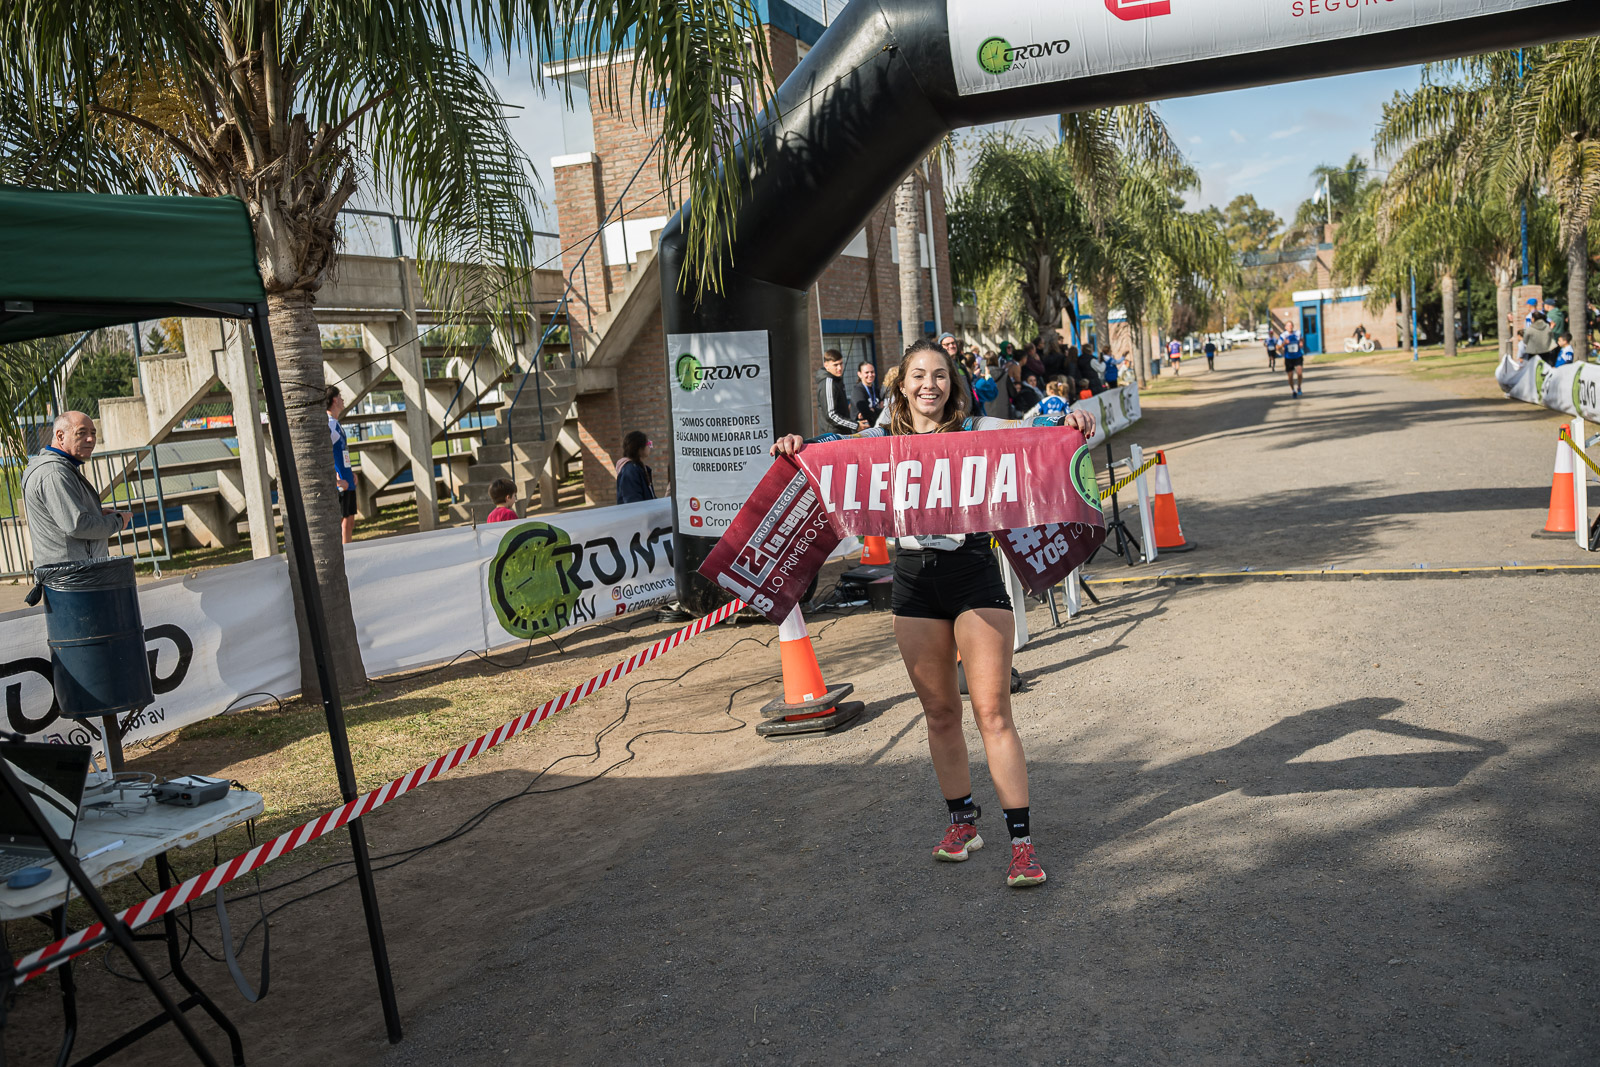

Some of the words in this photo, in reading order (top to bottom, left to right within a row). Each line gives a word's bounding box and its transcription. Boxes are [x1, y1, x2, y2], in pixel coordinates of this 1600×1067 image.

[1291, 0, 1395, 17] SEGU
[1003, 62, 1027, 72] RAV
[692, 382, 715, 391] RAV
[705, 415, 761, 427] CORREDORES
[676, 431, 710, 443] BUSCANDO
[711, 430, 751, 442] MEJORAR
[753, 429, 769, 440] LAS
[681, 446, 731, 457] EXPERIENCIAS
[733, 446, 744, 457] DE
[746, 445, 762, 455] LOS
[820, 453, 1018, 513] LLEGADA
[754, 515, 777, 544] GRUPO
[767, 576, 785, 595] LO
[779, 528, 818, 577] PRIMERO
[1025, 533, 1069, 574] VOS
[554, 594, 597, 630] RAV
